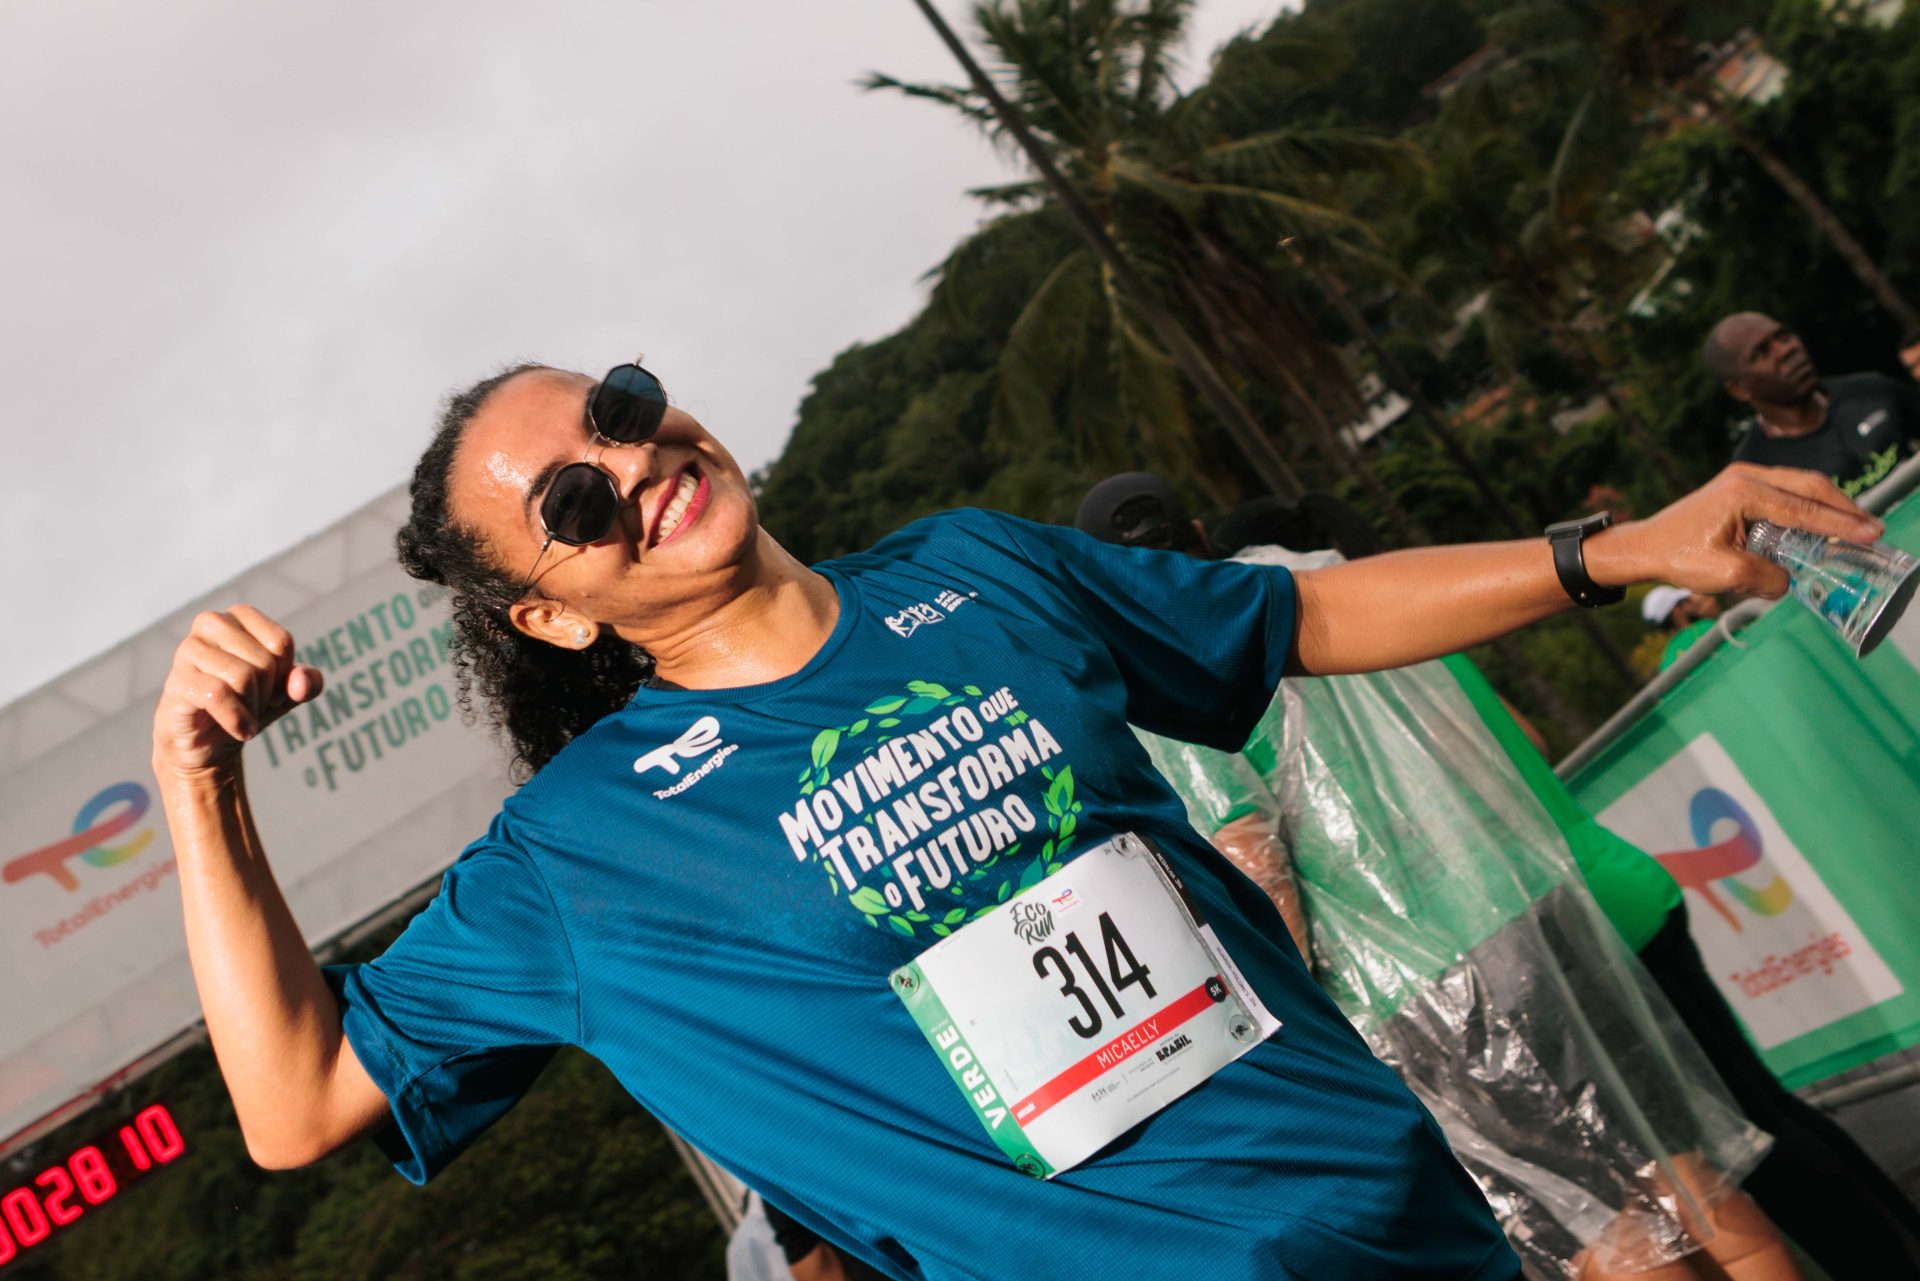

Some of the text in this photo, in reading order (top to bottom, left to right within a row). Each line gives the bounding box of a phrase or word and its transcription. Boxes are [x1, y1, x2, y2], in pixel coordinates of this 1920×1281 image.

[295, 592, 416, 674] MENTO
[261, 619, 457, 769] TRANSFORM
[315, 683, 451, 792] FUTURO
[652, 743, 740, 800] TotalEnergies
[778, 686, 1019, 862] MOVIMENTO QUE
[818, 718, 1063, 891] TRANSFORMA
[33, 857, 177, 949] TotalEnergie
[892, 793, 1036, 912] FUTURO
[1031, 910, 1158, 1040] 314
[1209, 983, 1223, 997] 5K
[934, 1025, 1008, 1130] VERDE
[1096, 1018, 1160, 1069] MICAELLY
